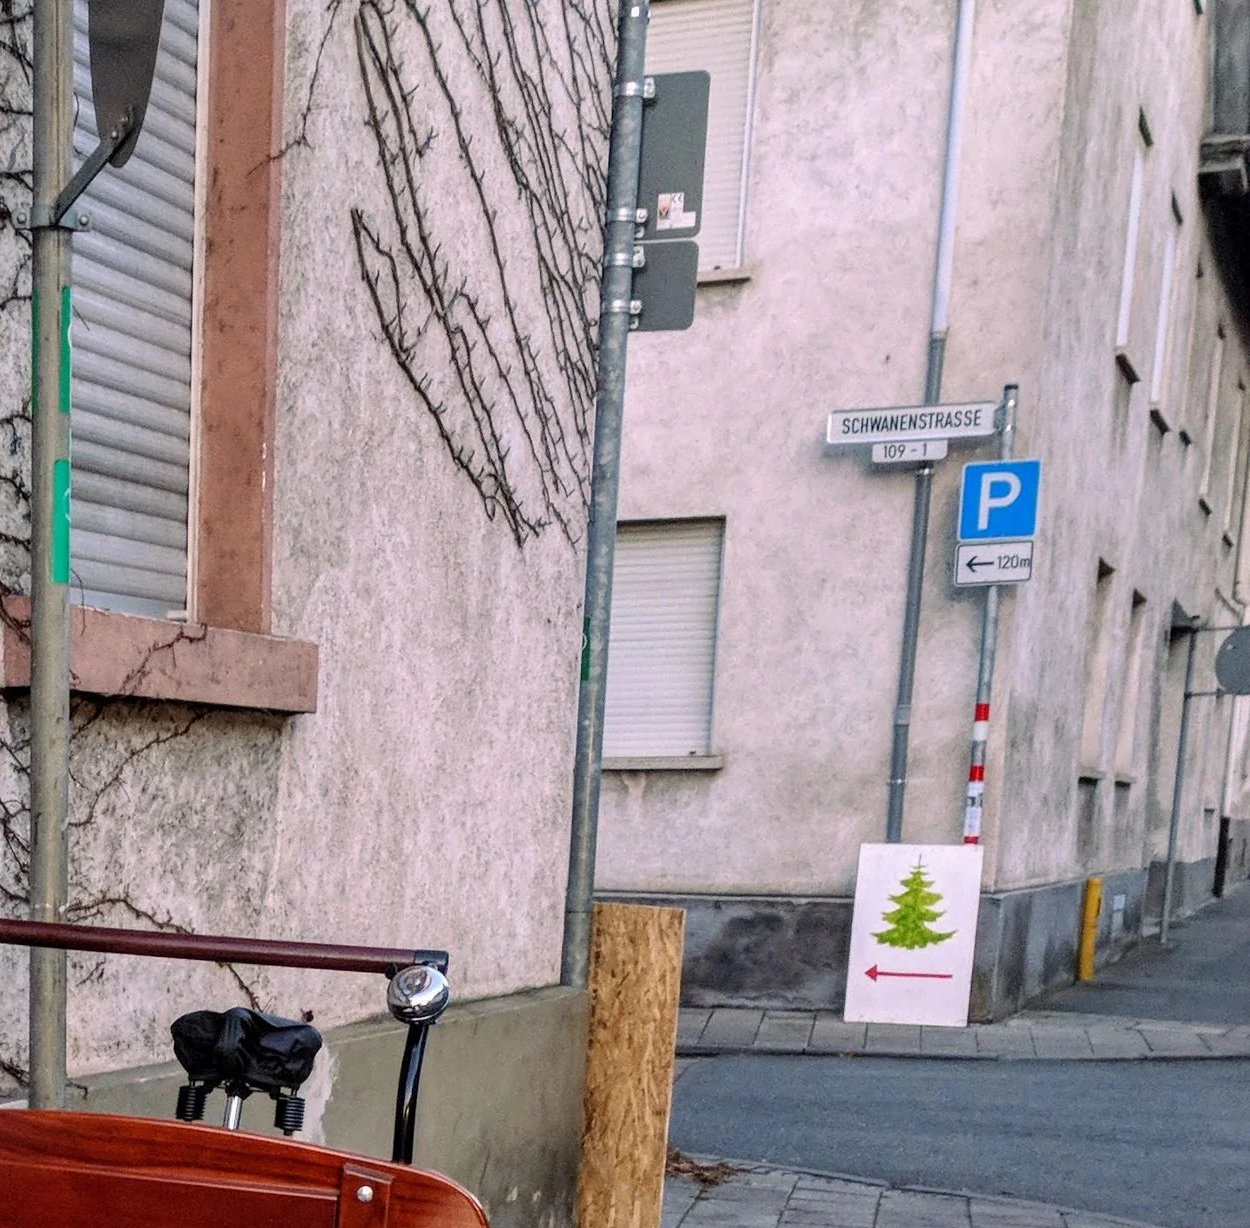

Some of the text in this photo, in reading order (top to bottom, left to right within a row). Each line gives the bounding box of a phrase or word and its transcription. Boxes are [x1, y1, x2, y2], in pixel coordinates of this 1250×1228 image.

[841, 408, 982, 435] SCHWANENSTRASSE
[882, 445, 906, 459] 109
[977, 471, 1022, 531] P
[996, 554, 1031, 570] 120m
